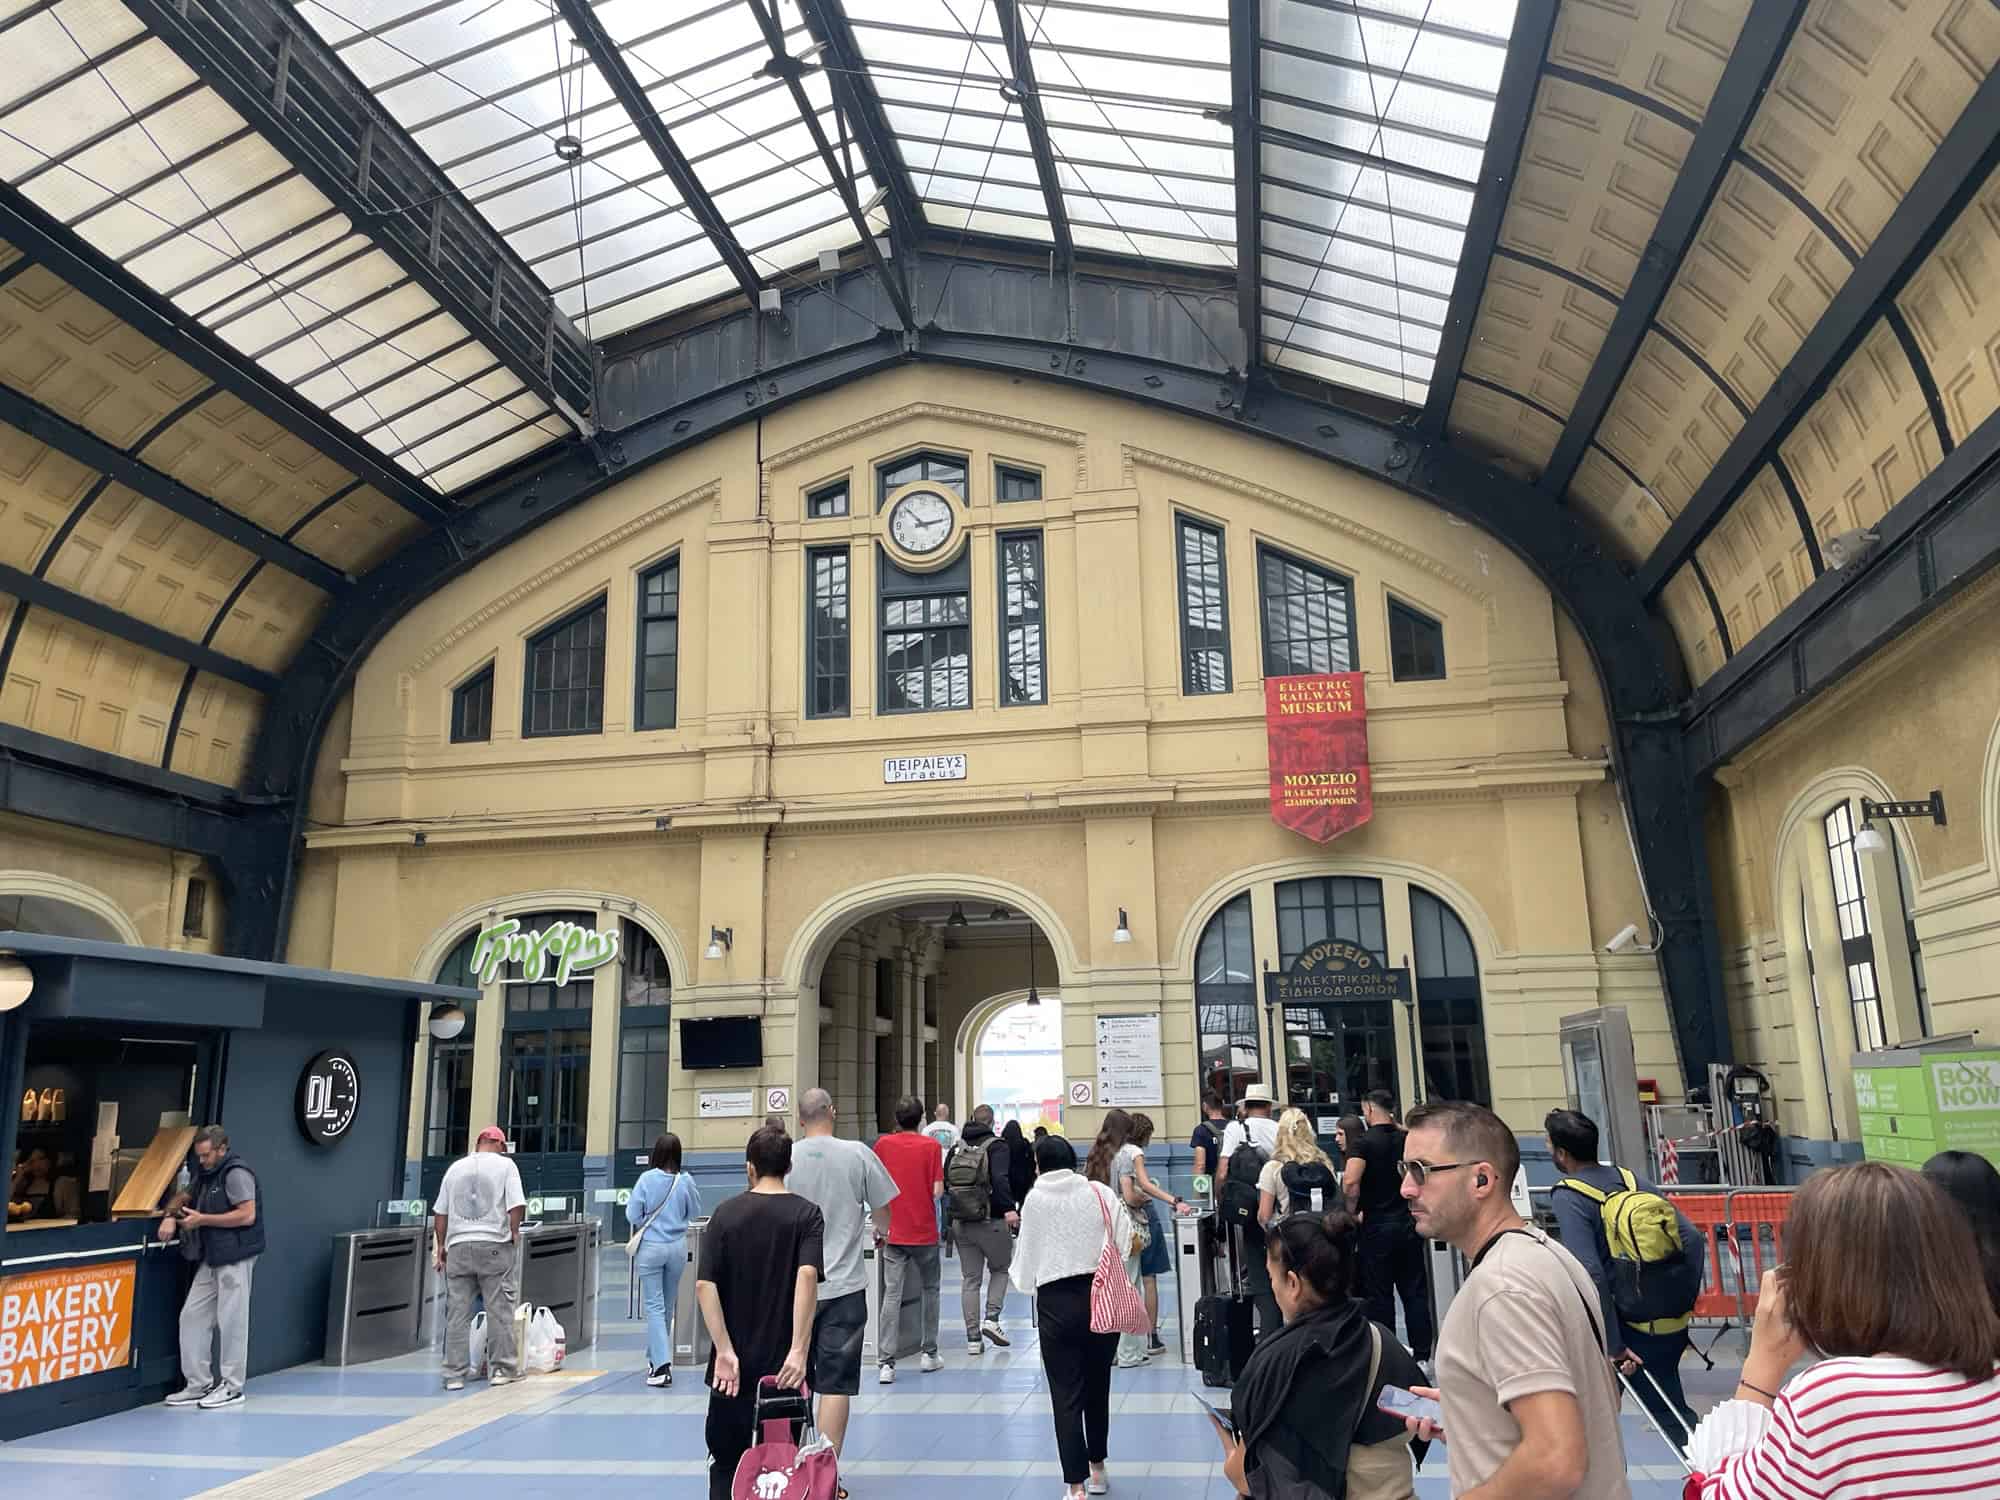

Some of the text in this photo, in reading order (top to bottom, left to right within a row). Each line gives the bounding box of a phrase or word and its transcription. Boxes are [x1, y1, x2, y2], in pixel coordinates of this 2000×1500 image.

[1280, 680, 1352, 692] ELECTRIC
[1280, 690, 1352, 702] RAILWAYS
[1280, 701, 1352, 714] MUSEUM
[888, 756, 963, 772] ΠΕΙΡΑΙΕΥΣ
[895, 770, 956, 781] Piraeus
[1284, 773, 1357, 786] ΜΟΥΣΕΙΟ
[1284, 787, 1357, 797] ΗΛΕΚΤΡΙΚΩΝ
[1300, 944, 1371, 970] ΜΟΥΣΕΙΟ
[1294, 974, 1381, 986] ΗΛΕΚΤΡΙΚΩΝ
[1279, 985, 1397, 998] ΣΙΔΗΡΟΔΡΟΜΩΝ
[1938, 1066, 1991, 1086] BOX
[306, 1075, 338, 1118] DL
[1942, 1087, 2000, 1106] NOW
[2, 1279, 121, 1330] BAKERY
[0, 1313, 119, 1368] BAKERY
